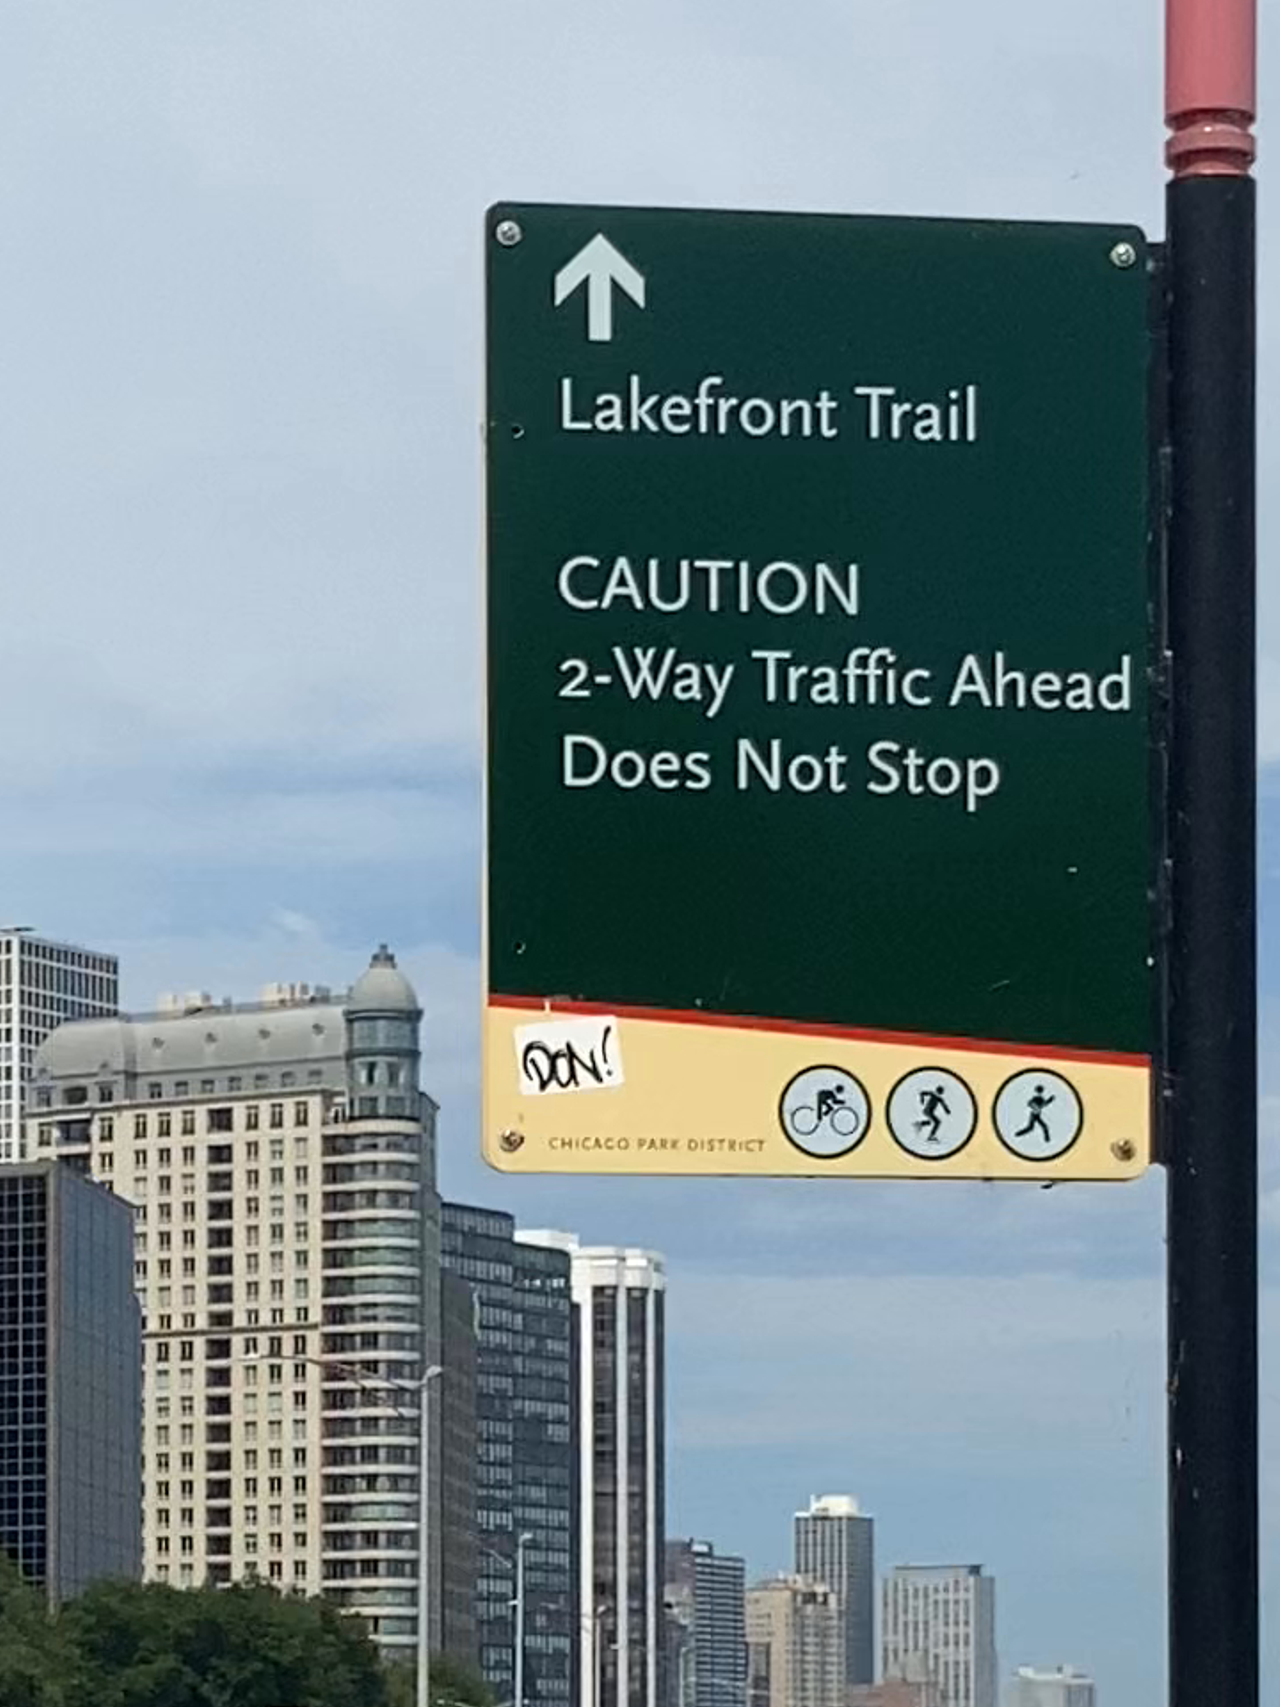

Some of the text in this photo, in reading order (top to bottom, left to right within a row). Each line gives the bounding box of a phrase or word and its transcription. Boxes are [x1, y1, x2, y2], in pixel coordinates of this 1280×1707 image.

[560, 373, 978, 442] Lakefront Trail
[558, 555, 860, 615] CAUTION
[558, 646, 1132, 719] 2-Way Traffic Ahead
[561, 734, 1001, 812] Does Not Stop
[522, 1025, 613, 1092] DON!
[548, 1137, 767, 1153] CHICAGO PARK DISTRICT
